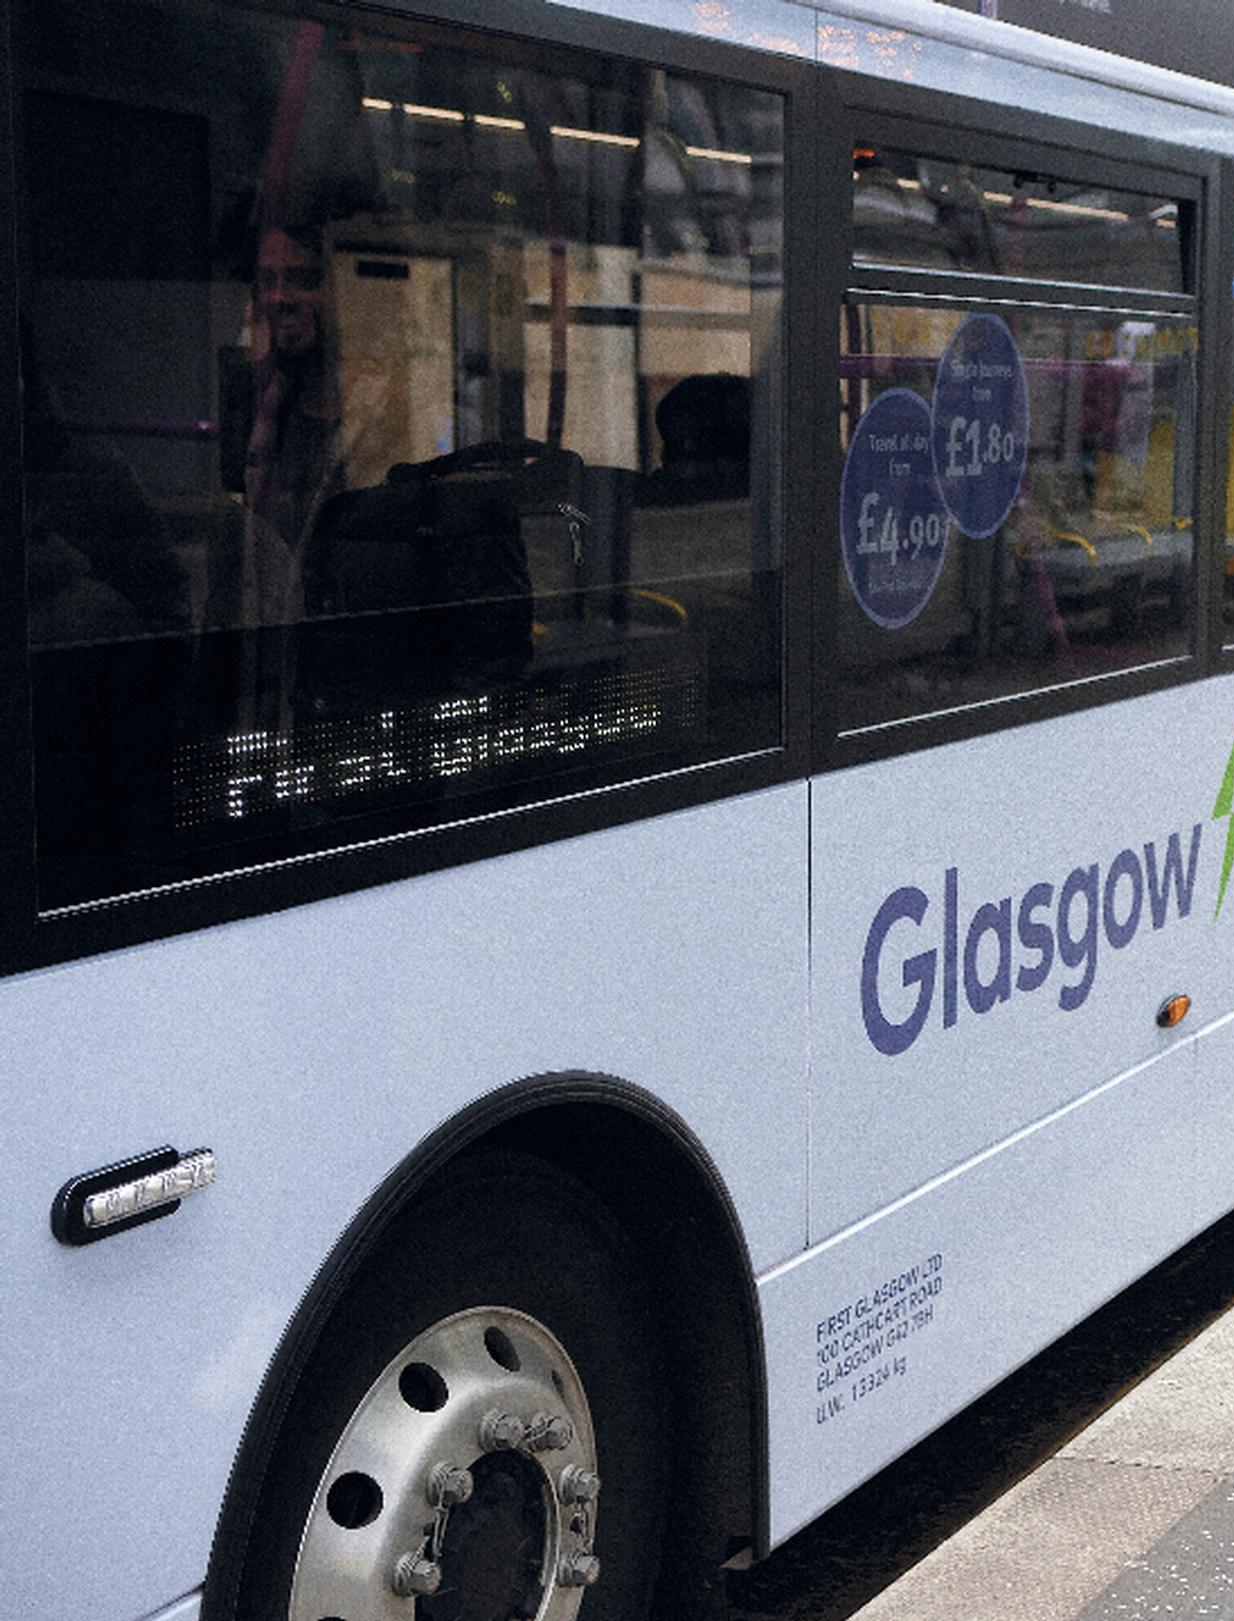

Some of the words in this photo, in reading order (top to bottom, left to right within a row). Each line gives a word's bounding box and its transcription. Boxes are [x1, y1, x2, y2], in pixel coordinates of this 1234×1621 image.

[945, 416, 1014, 477] £1.80
[856, 492, 940, 566] £4.90
[861, 823, 1202, 1056] Glasgow
[816, 1305, 851, 1343] FIRST
[855, 1265, 919, 1318] GLASGOW
[922, 1253, 942, 1279] LTD
[841, 1296, 907, 1352] CATHCART
[909, 1275, 942, 1312] ROAD
[816, 1334, 884, 1393] GLASGOW
